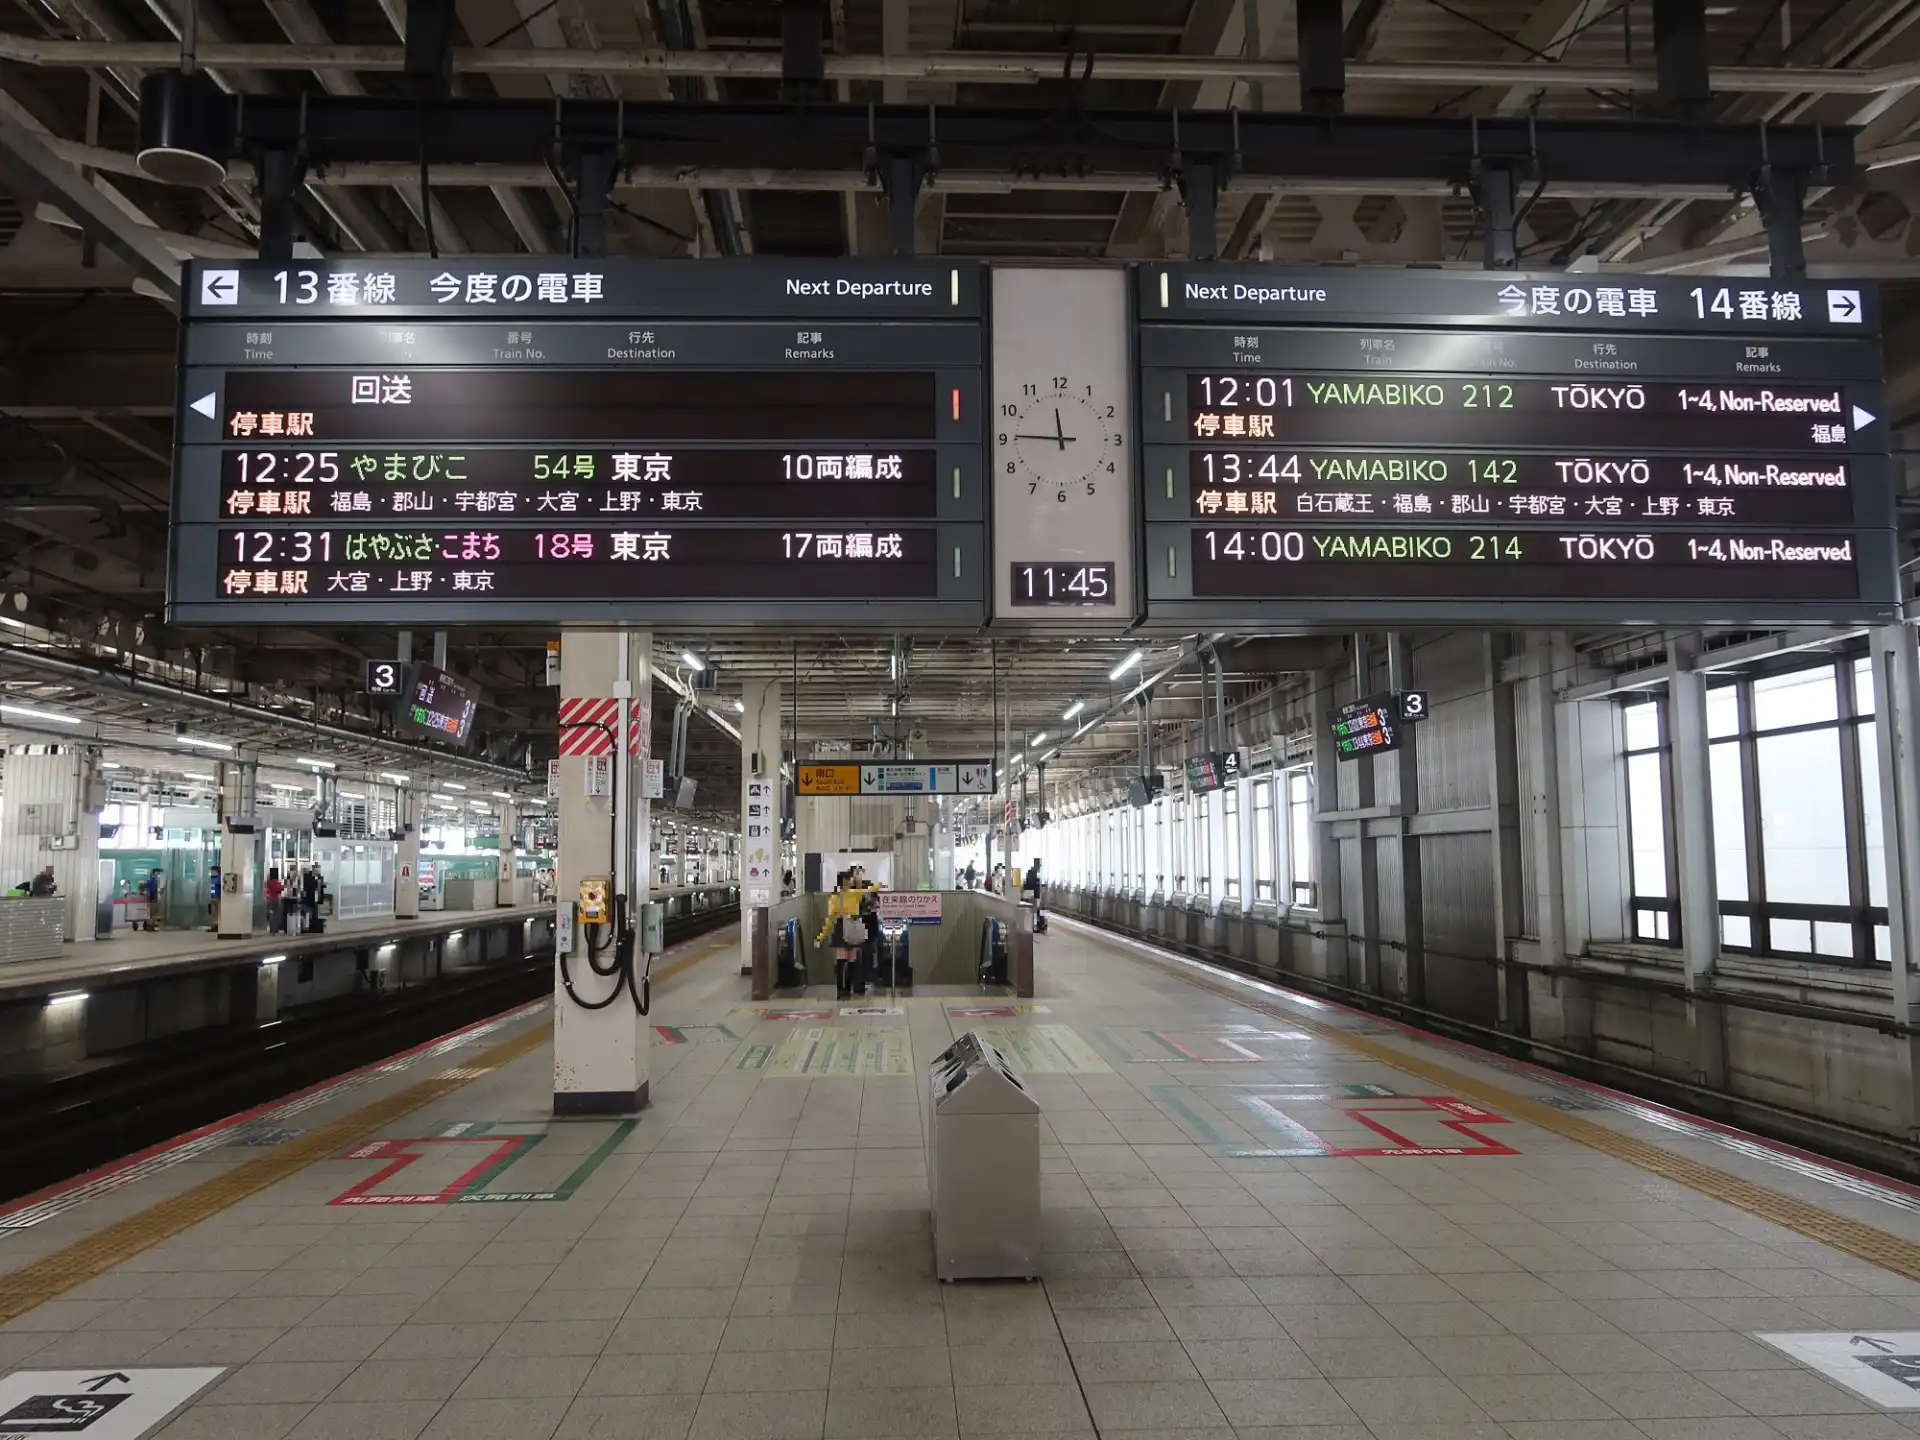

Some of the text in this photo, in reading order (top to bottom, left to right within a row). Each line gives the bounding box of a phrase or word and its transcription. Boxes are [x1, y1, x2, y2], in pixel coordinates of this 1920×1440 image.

[274, 270, 604, 305] 13番線 今度の電車
[786, 279, 933, 301] Next Departure
[1185, 283, 1327, 304] Next Departure
[1497, 284, 1803, 321] 今度の電車 14番線
[246, 332, 273, 345] 時刻
[507, 332, 533, 345] 番号
[628, 331, 655, 344] 行先
[797, 331, 823, 344] 記事
[1234, 336, 1259, 349] 時刻
[244, 348, 274, 360] Time
[492, 348, 546, 359] Train No.
[607, 347, 676, 359] Destination
[785, 348, 835, 359] Remarks
[1592, 343, 1617, 356] 行先
[1745, 347, 1769, 359] 記事
[1232, 352, 1262, 363] Time
[1574, 358, 1638, 370] Destination
[1735, 362, 1781, 373] Remarks
[351, 375, 413, 404] 回送
[1052, 377, 1068, 389] 12
[1022, 384, 1037, 396] 11
[1086, 385, 1092, 396] 1
[1200, 376, 1294, 407] 12:01
[1306, 382, 1444, 406] YAMABIKO
[1462, 384, 1514, 408] 212
[1551, 383, 1646, 410] TŌKYŌ
[1001, 404, 1017, 417] 10
[1106, 406, 1115, 418] 2
[230, 411, 314, 436] 停車駅
[1194, 412, 1275, 438] 停車駅
[998, 434, 1008, 446] 9
[1113, 434, 1122, 446] 3
[1810, 423, 1847, 444] 福島
[237, 452, 903, 483] 12:25 やまびこ 54号 東京 10両編成
[1006, 462, 1016, 474] 8
[1106, 462, 1116, 474] 4
[1203, 453, 1302, 484] 13:44
[1309, 458, 1448, 481] YAMABIKO
[1468, 459, 1518, 484] 142
[1555, 458, 1650, 484] TŌKYŌ
[1028, 482, 1037, 495] 7
[1086, 483, 1096, 495] 5
[226, 489, 312, 515] 停車駅
[1057, 491, 1067, 503] 6
[1195, 490, 1278, 515] 停車駅
[234, 531, 331, 563] 12:31
[535, 533, 594, 559] 18号
[610, 531, 672, 561] 東京
[782, 533, 903, 559] 17両編成
[1205, 531, 1305, 561] 14:00
[1312, 536, 1452, 558] YAMABIKO
[1469, 536, 1523, 560] 214
[1560, 534, 1655, 560] TŌKYŌ
[223, 569, 309, 595] 停車駅
[1022, 567, 1108, 597] 11:45
[375, 664, 394, 687] 3
[1406, 693, 1423, 713] 3
[1225, 753, 1237, 767] 4
